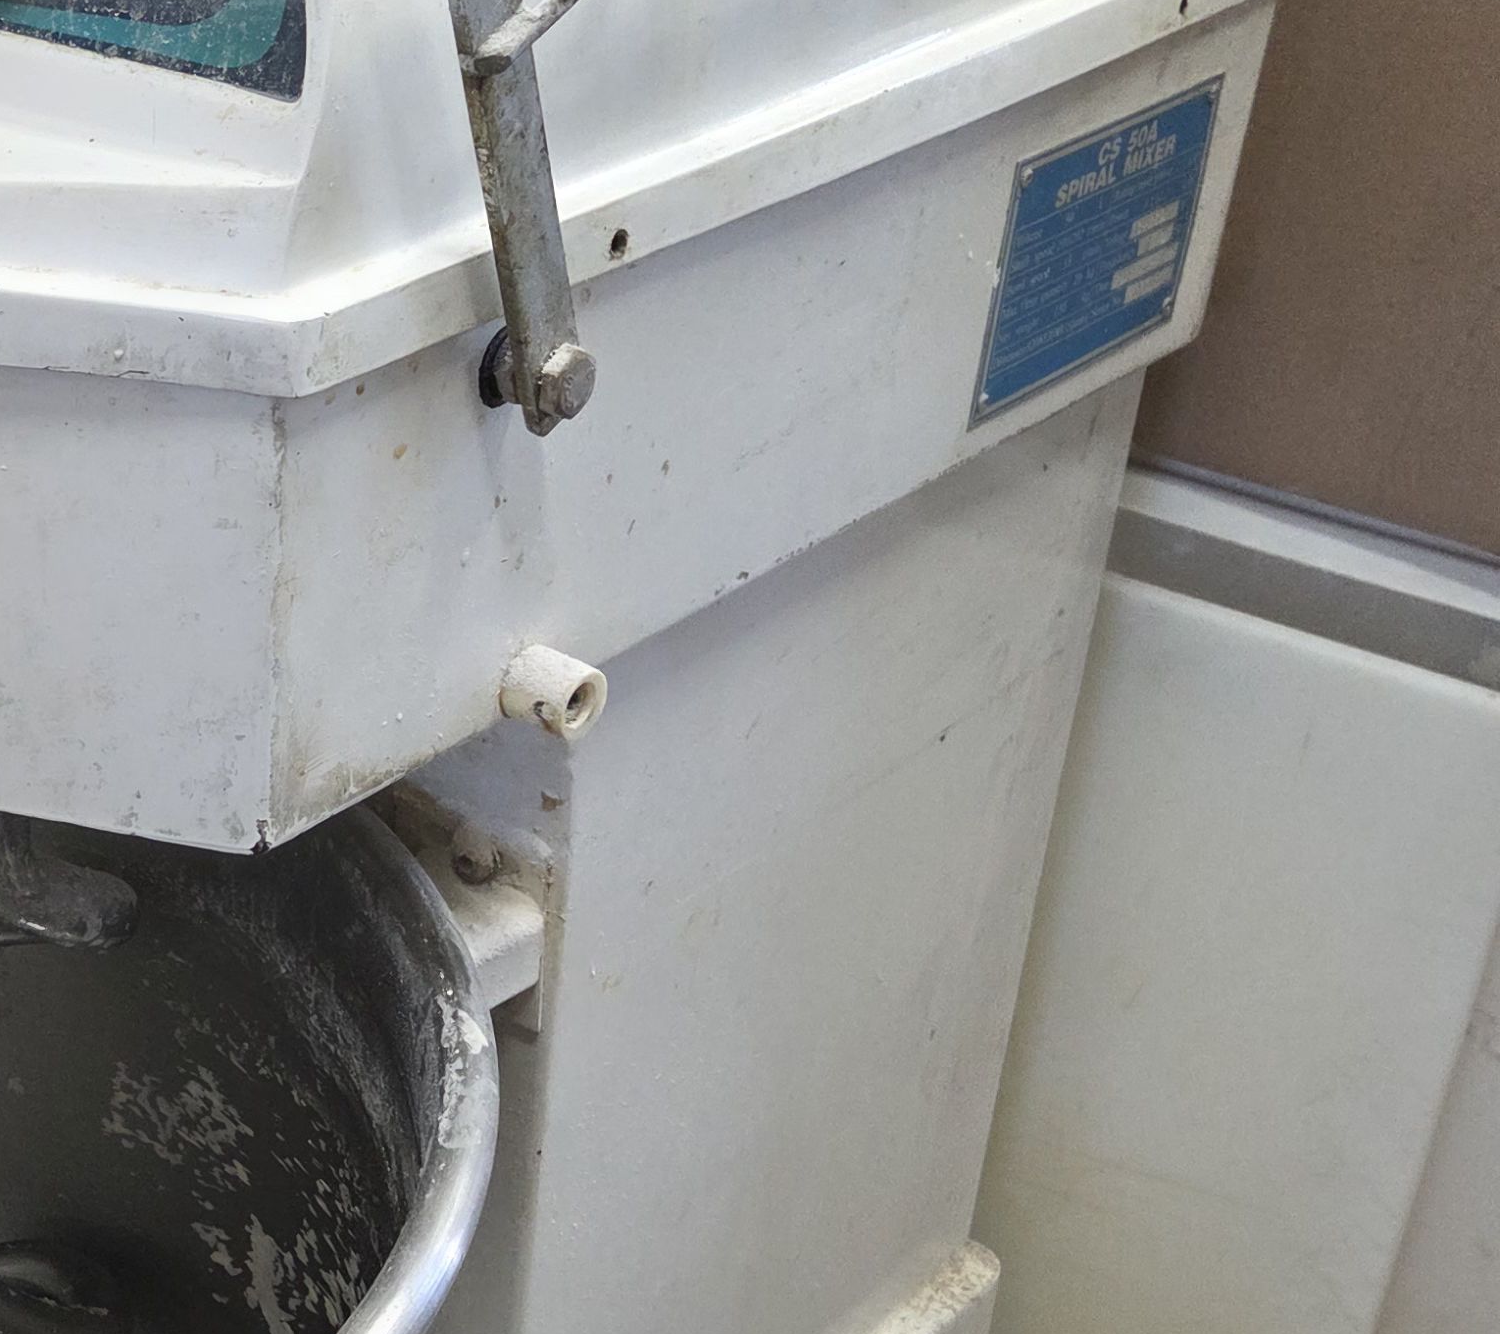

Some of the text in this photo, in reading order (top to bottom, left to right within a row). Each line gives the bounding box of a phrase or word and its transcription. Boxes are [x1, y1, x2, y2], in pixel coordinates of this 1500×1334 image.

[1055, 133, 1177, 208] SPIRAL MIXER
[1097, 136, 1122, 167] CS
